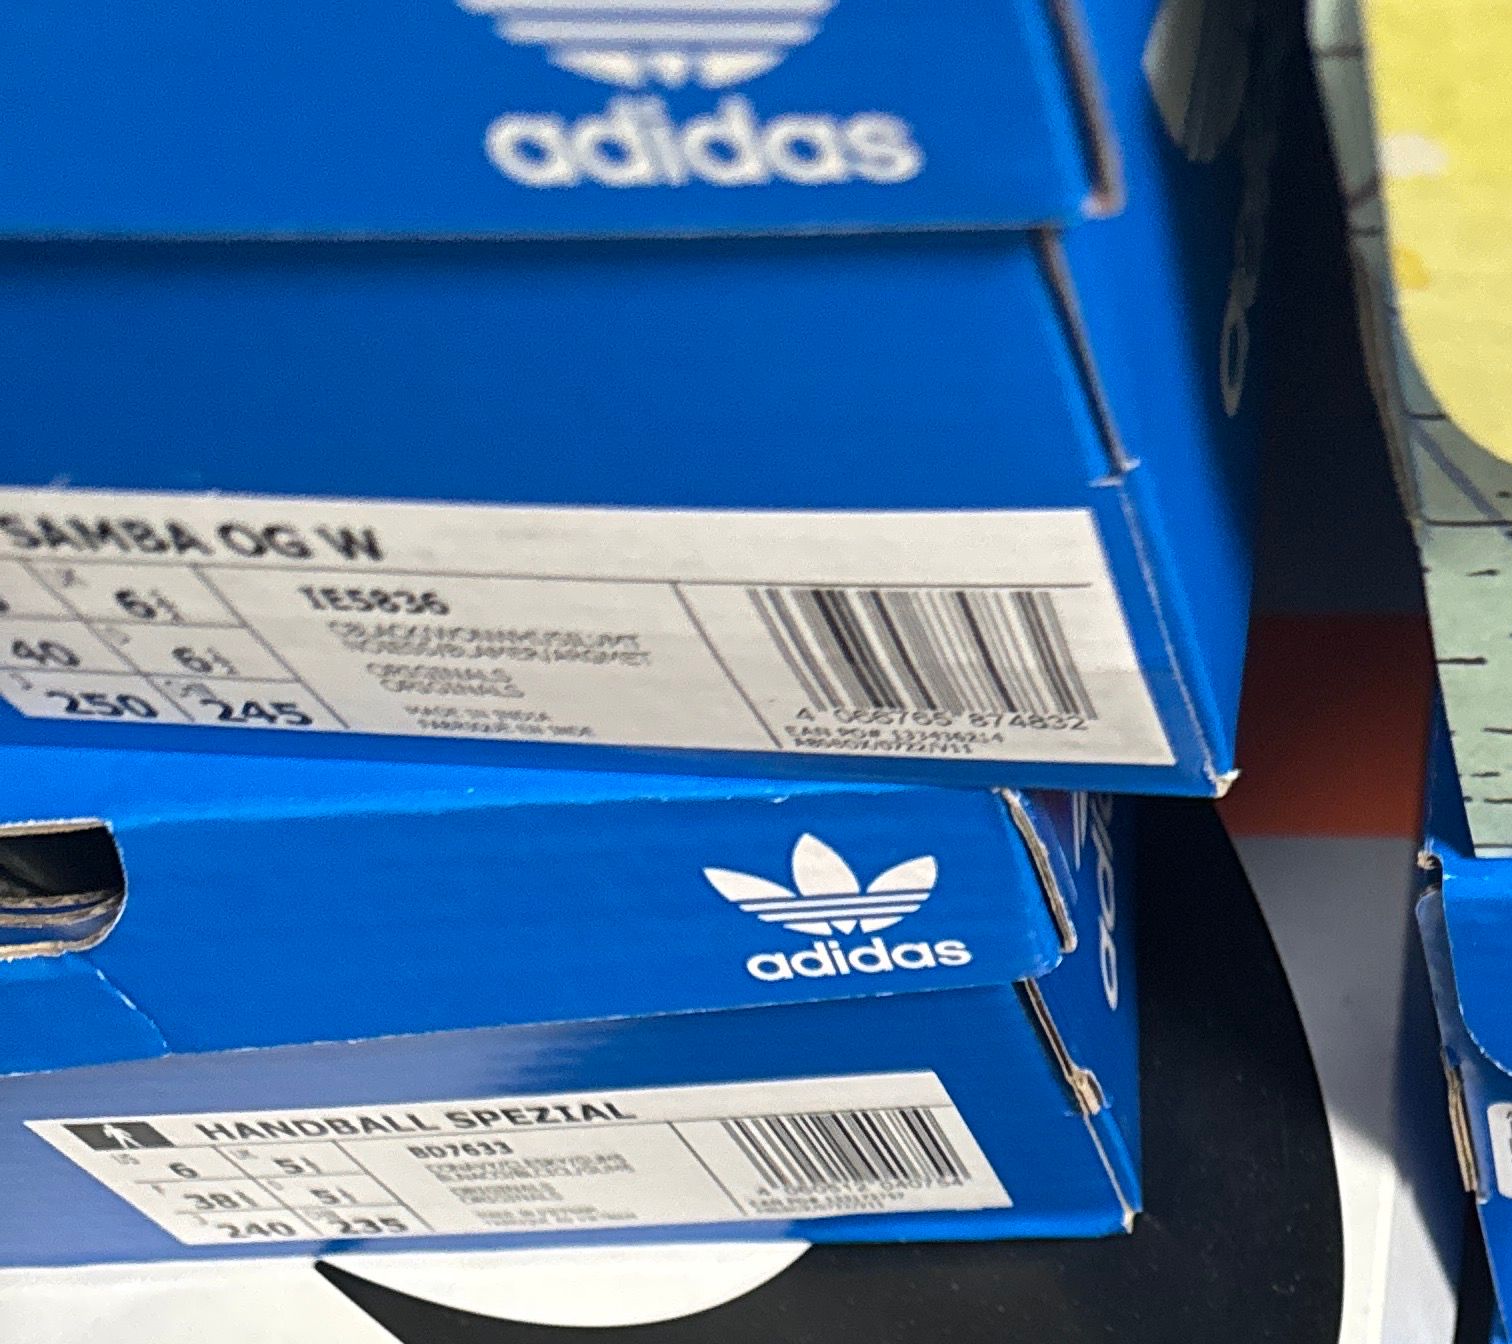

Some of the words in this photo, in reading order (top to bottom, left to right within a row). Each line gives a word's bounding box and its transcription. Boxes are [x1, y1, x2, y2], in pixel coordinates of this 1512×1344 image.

[485, 94, 925, 188] adidas
[0, 514, 214, 555] SAMBA
[216, 519, 313, 559] OG
[315, 523, 385, 562] W
[11, 639, 81, 668] 40
[46, 688, 158, 718] 250
[200, 699, 313, 726] 245
[746, 936, 973, 982] adidas
[195, 1113, 440, 1143] HANDBALL
[444, 1102, 637, 1129] SPEZIAL
[407, 1140, 514, 1158] BD7633
[169, 1161, 198, 1179] 6
[216, 1221, 297, 1239] 240
[334, 1217, 409, 1235] 235
